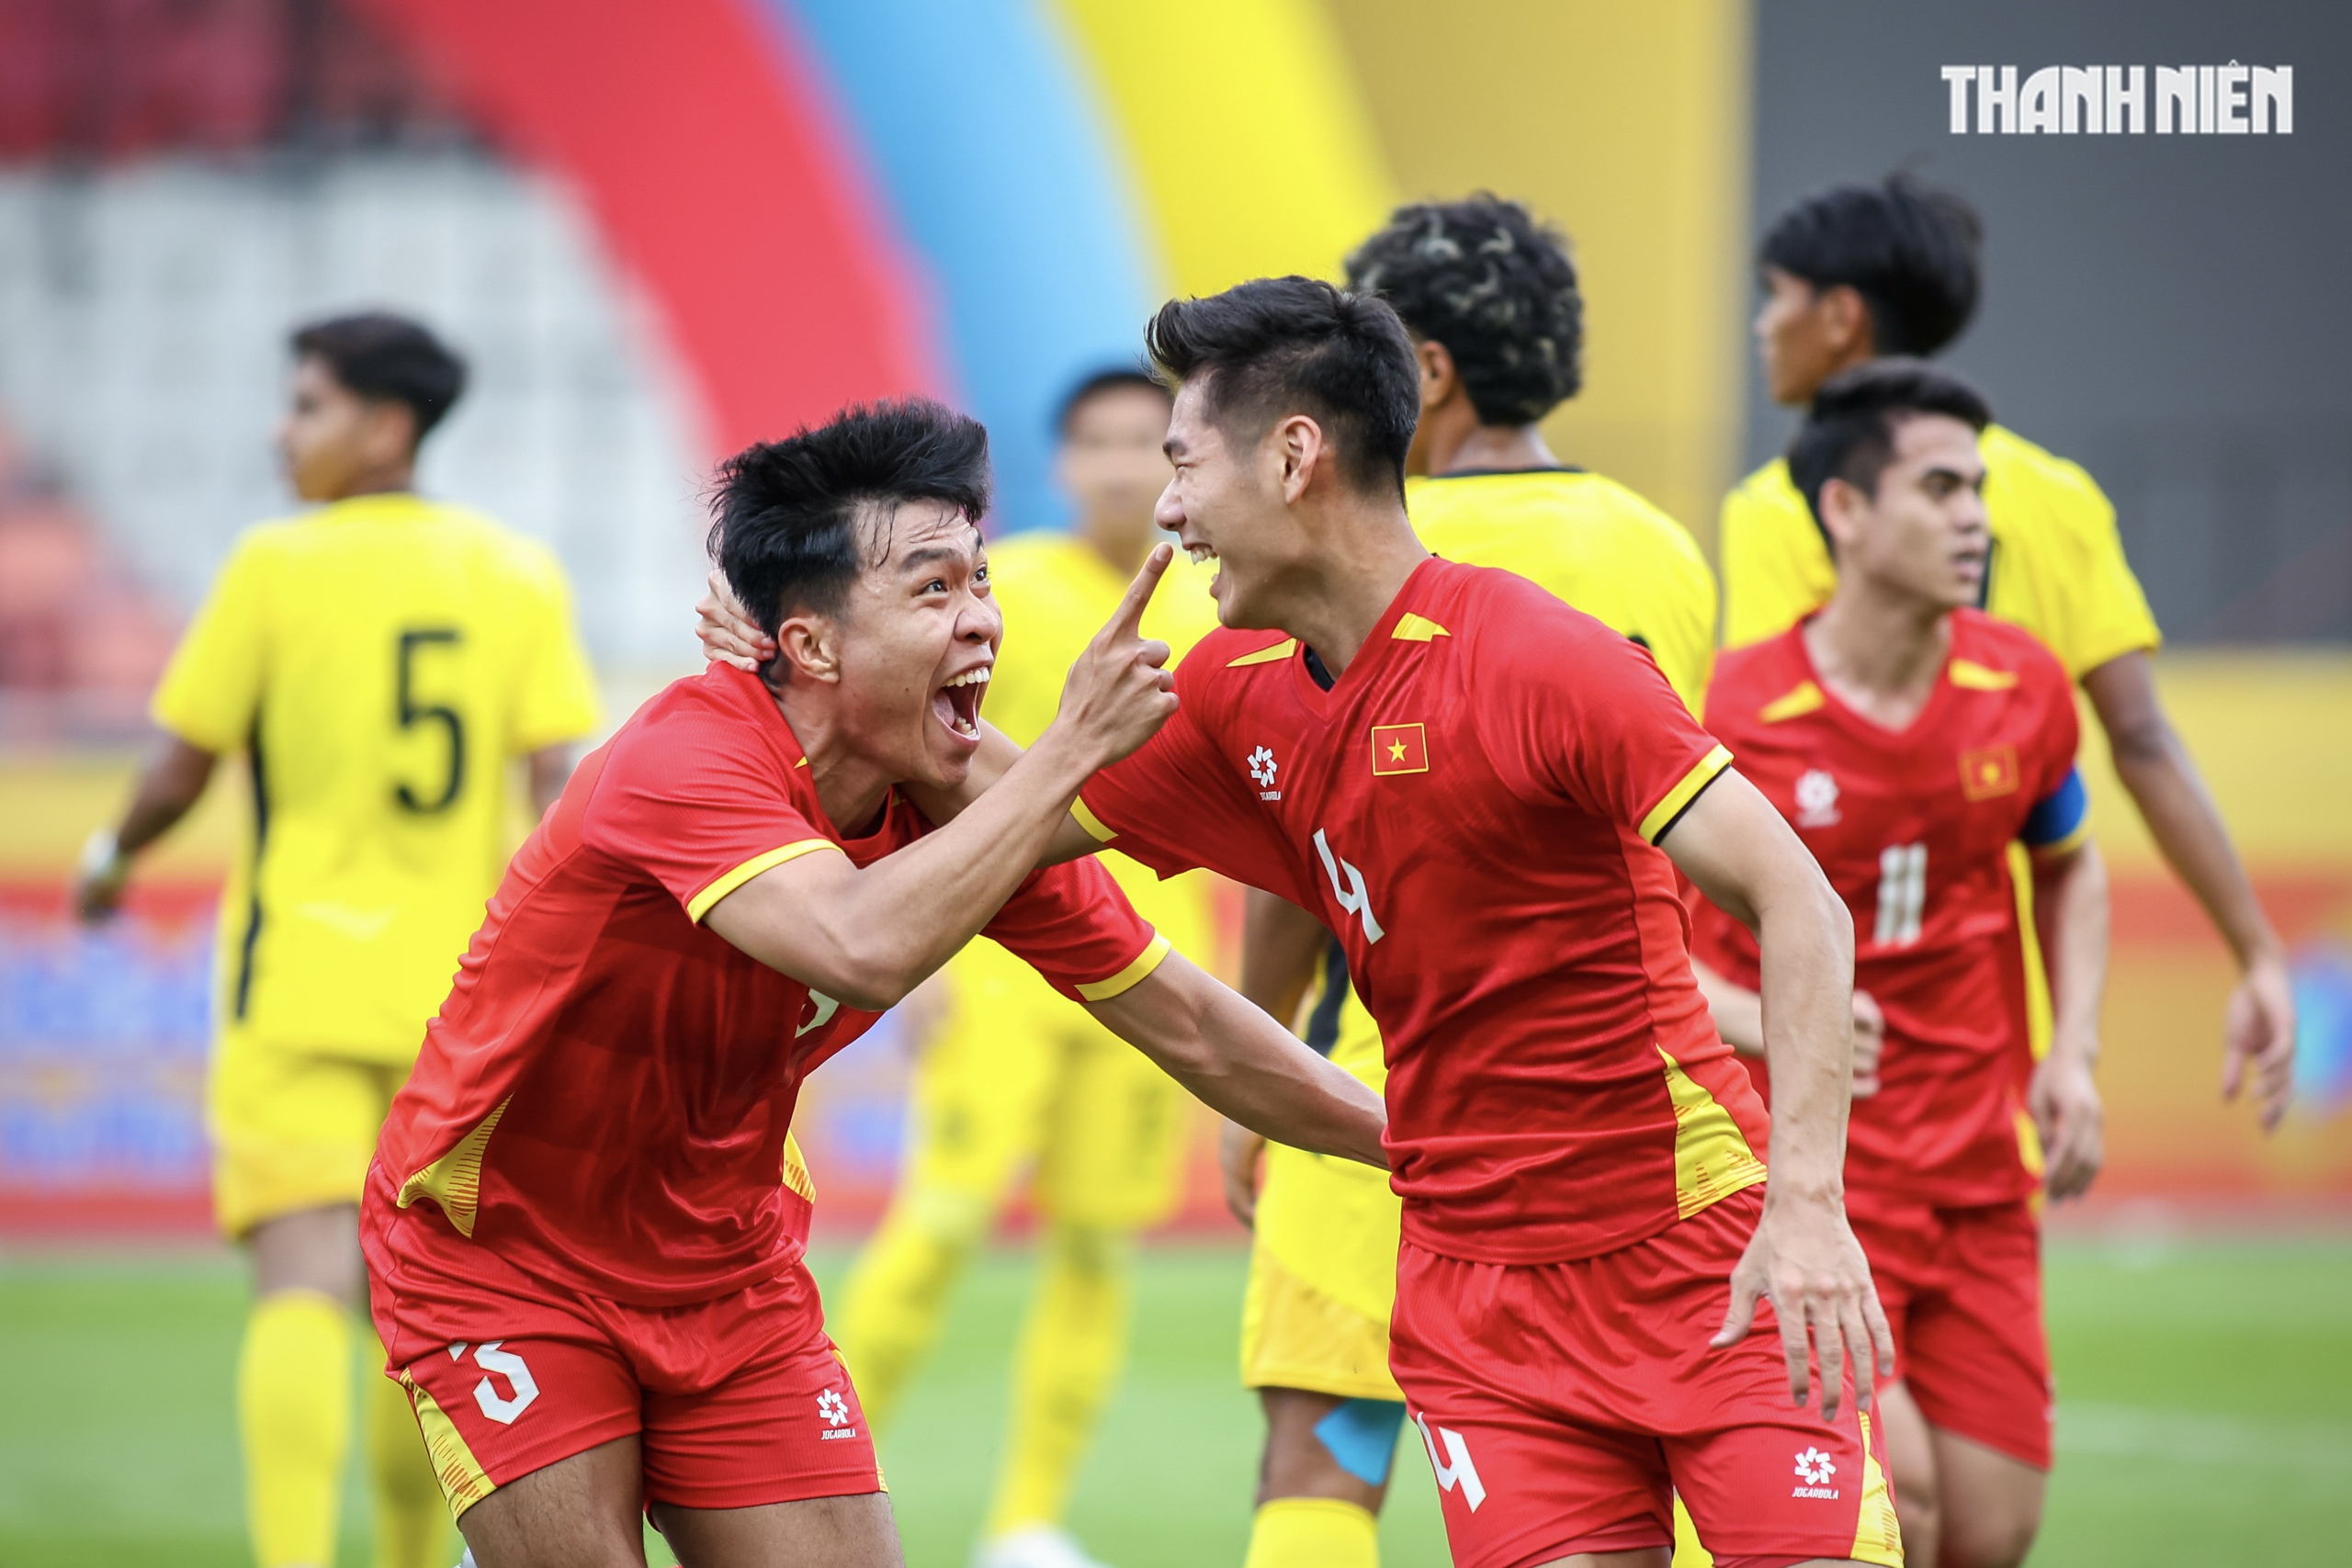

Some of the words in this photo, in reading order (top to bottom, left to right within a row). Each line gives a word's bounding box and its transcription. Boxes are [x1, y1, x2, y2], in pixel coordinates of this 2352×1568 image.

[396, 628, 466, 816] 5
[1312, 827, 1385, 945] 4
[1874, 842, 1928, 947] 11
[820, 1427, 856, 1440] JOGARBOLA
[1416, 1411, 1487, 1515] 4
[1791, 1486, 1839, 1500] JOGARBOLA
